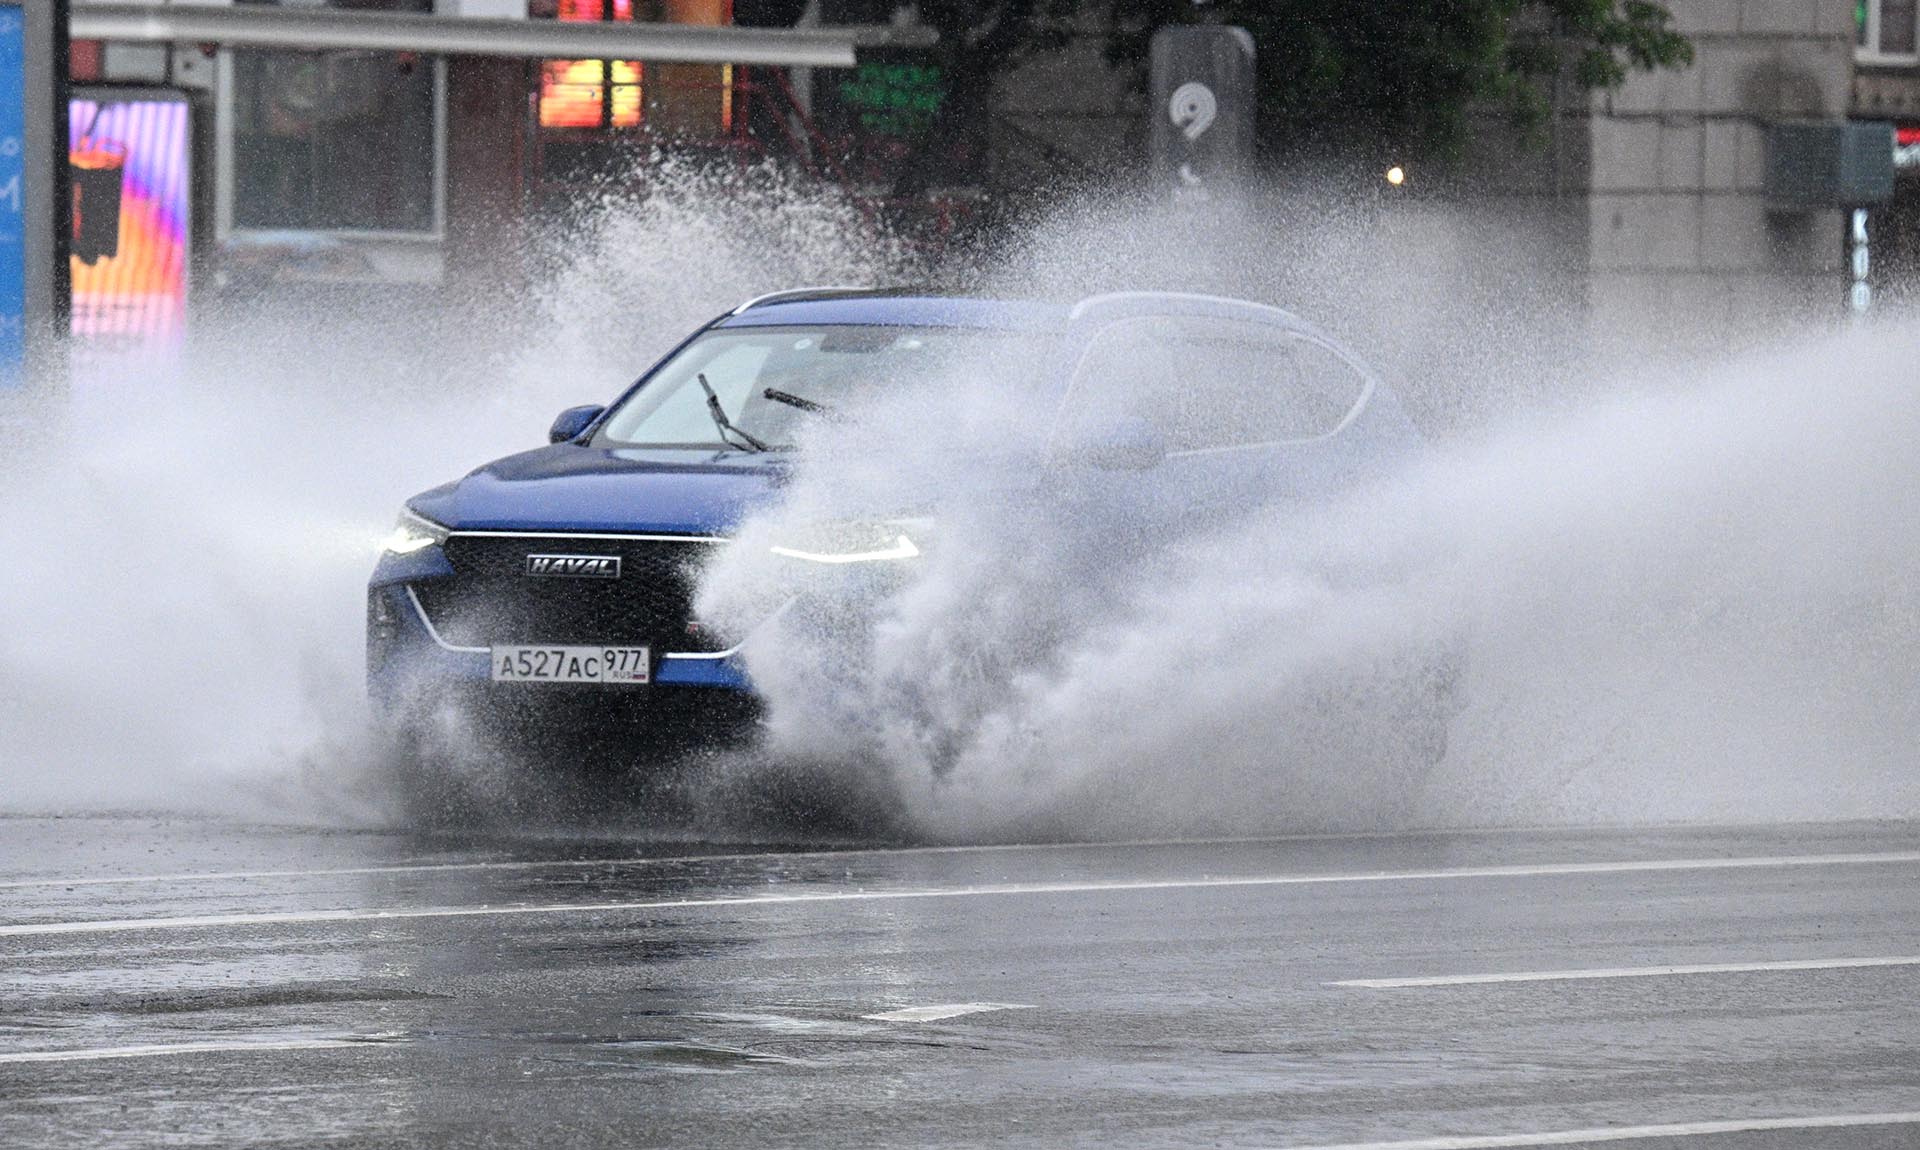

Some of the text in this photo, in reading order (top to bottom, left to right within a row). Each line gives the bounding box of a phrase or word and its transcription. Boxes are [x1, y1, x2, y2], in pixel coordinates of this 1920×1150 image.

[530, 557, 614, 574] HAVAL
[500, 649, 642, 679] A527AC 977
